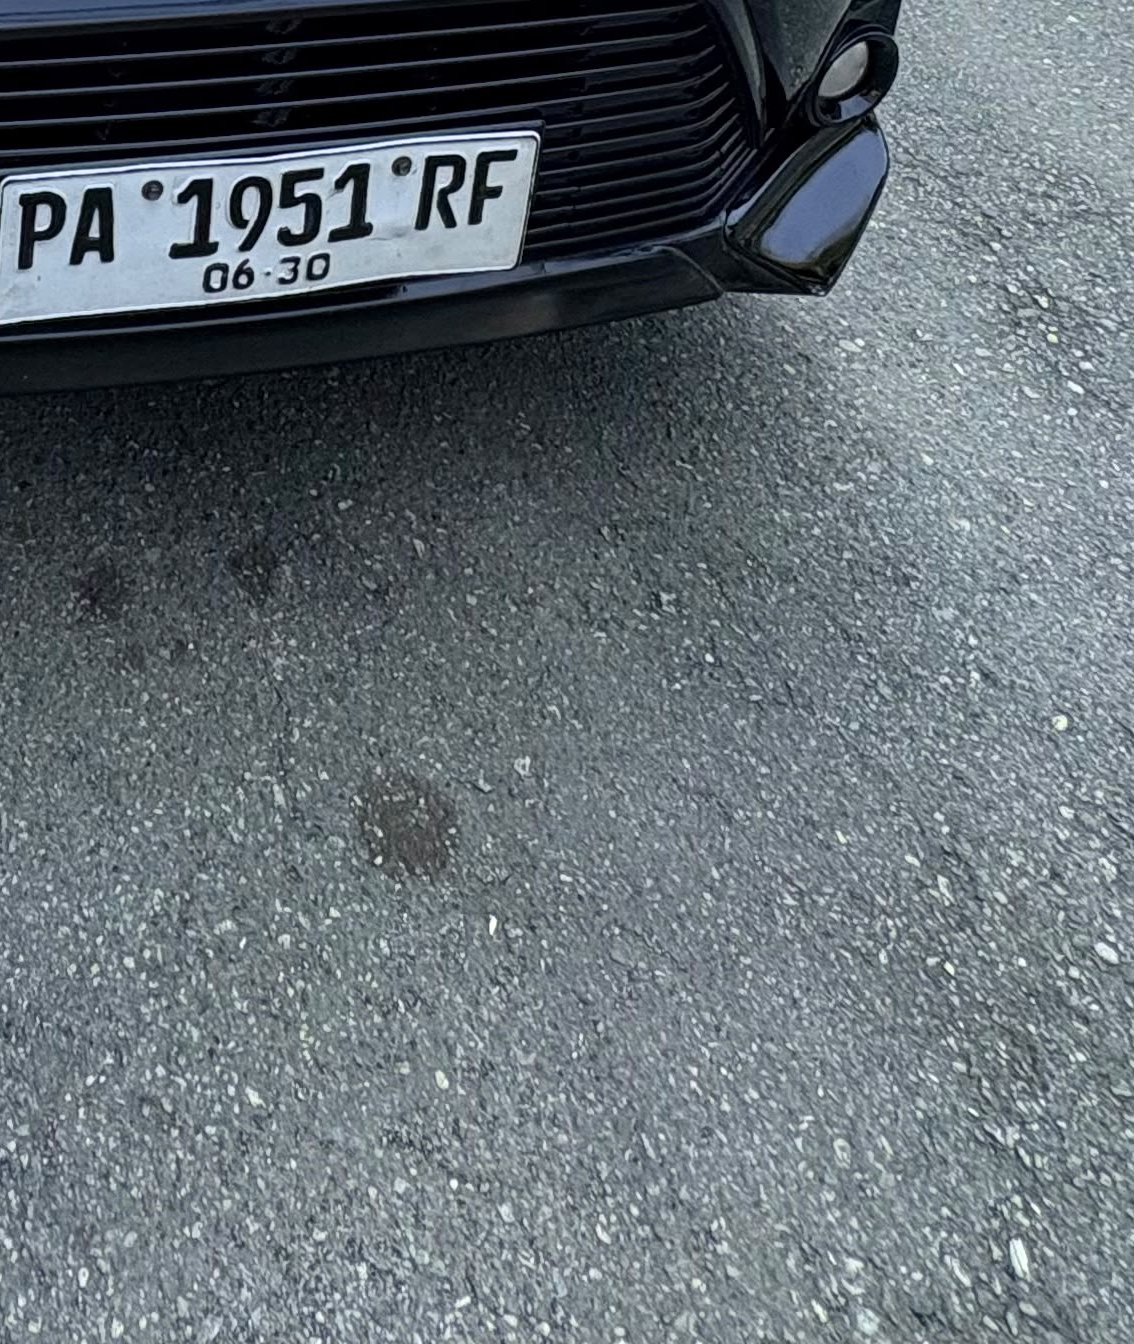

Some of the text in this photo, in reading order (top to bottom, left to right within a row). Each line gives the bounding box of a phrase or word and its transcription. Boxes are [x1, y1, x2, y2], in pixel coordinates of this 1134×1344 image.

[17, 149, 518, 270] PA 1951 RF
